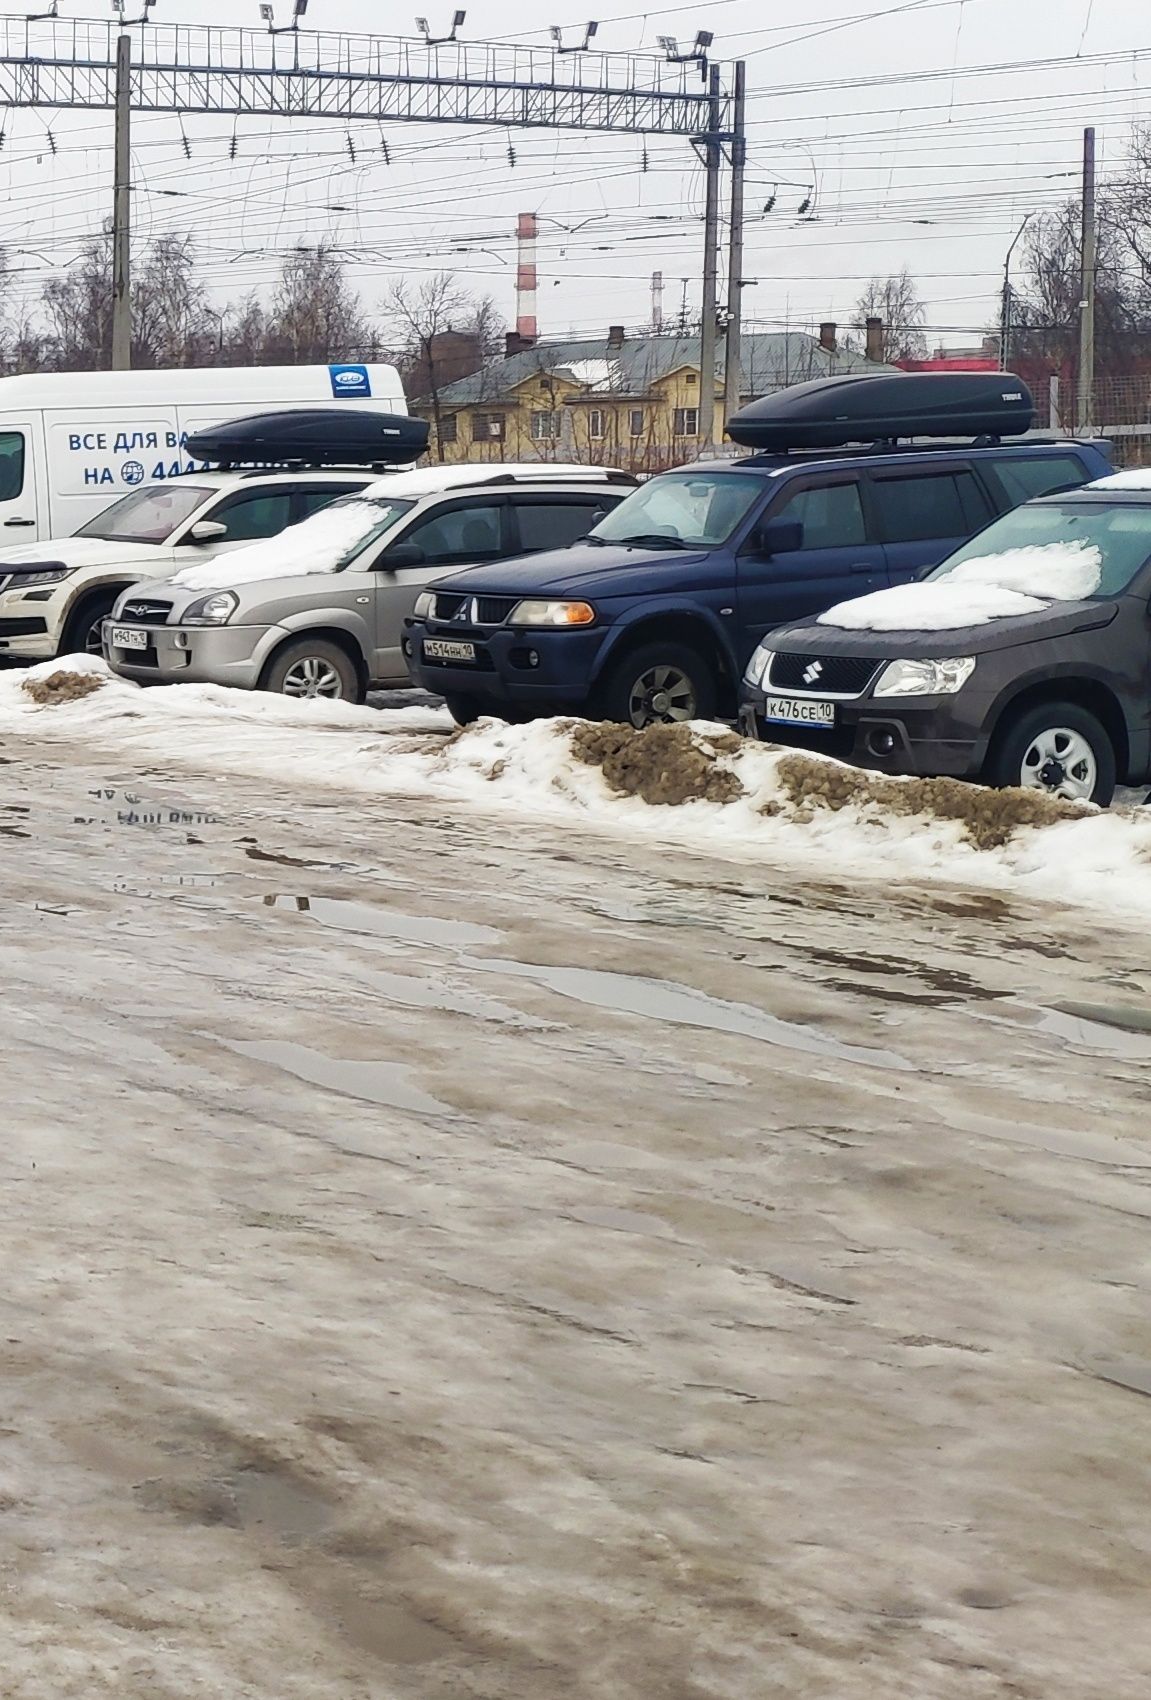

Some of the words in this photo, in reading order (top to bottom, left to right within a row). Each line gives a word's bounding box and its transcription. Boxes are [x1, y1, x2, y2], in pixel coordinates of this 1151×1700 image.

[68, 433, 107, 451] ВСЕ
[113, 431, 158, 454] ДЛЯ
[165, 431, 197, 450] ВА
[84, 467, 115, 485] НА
